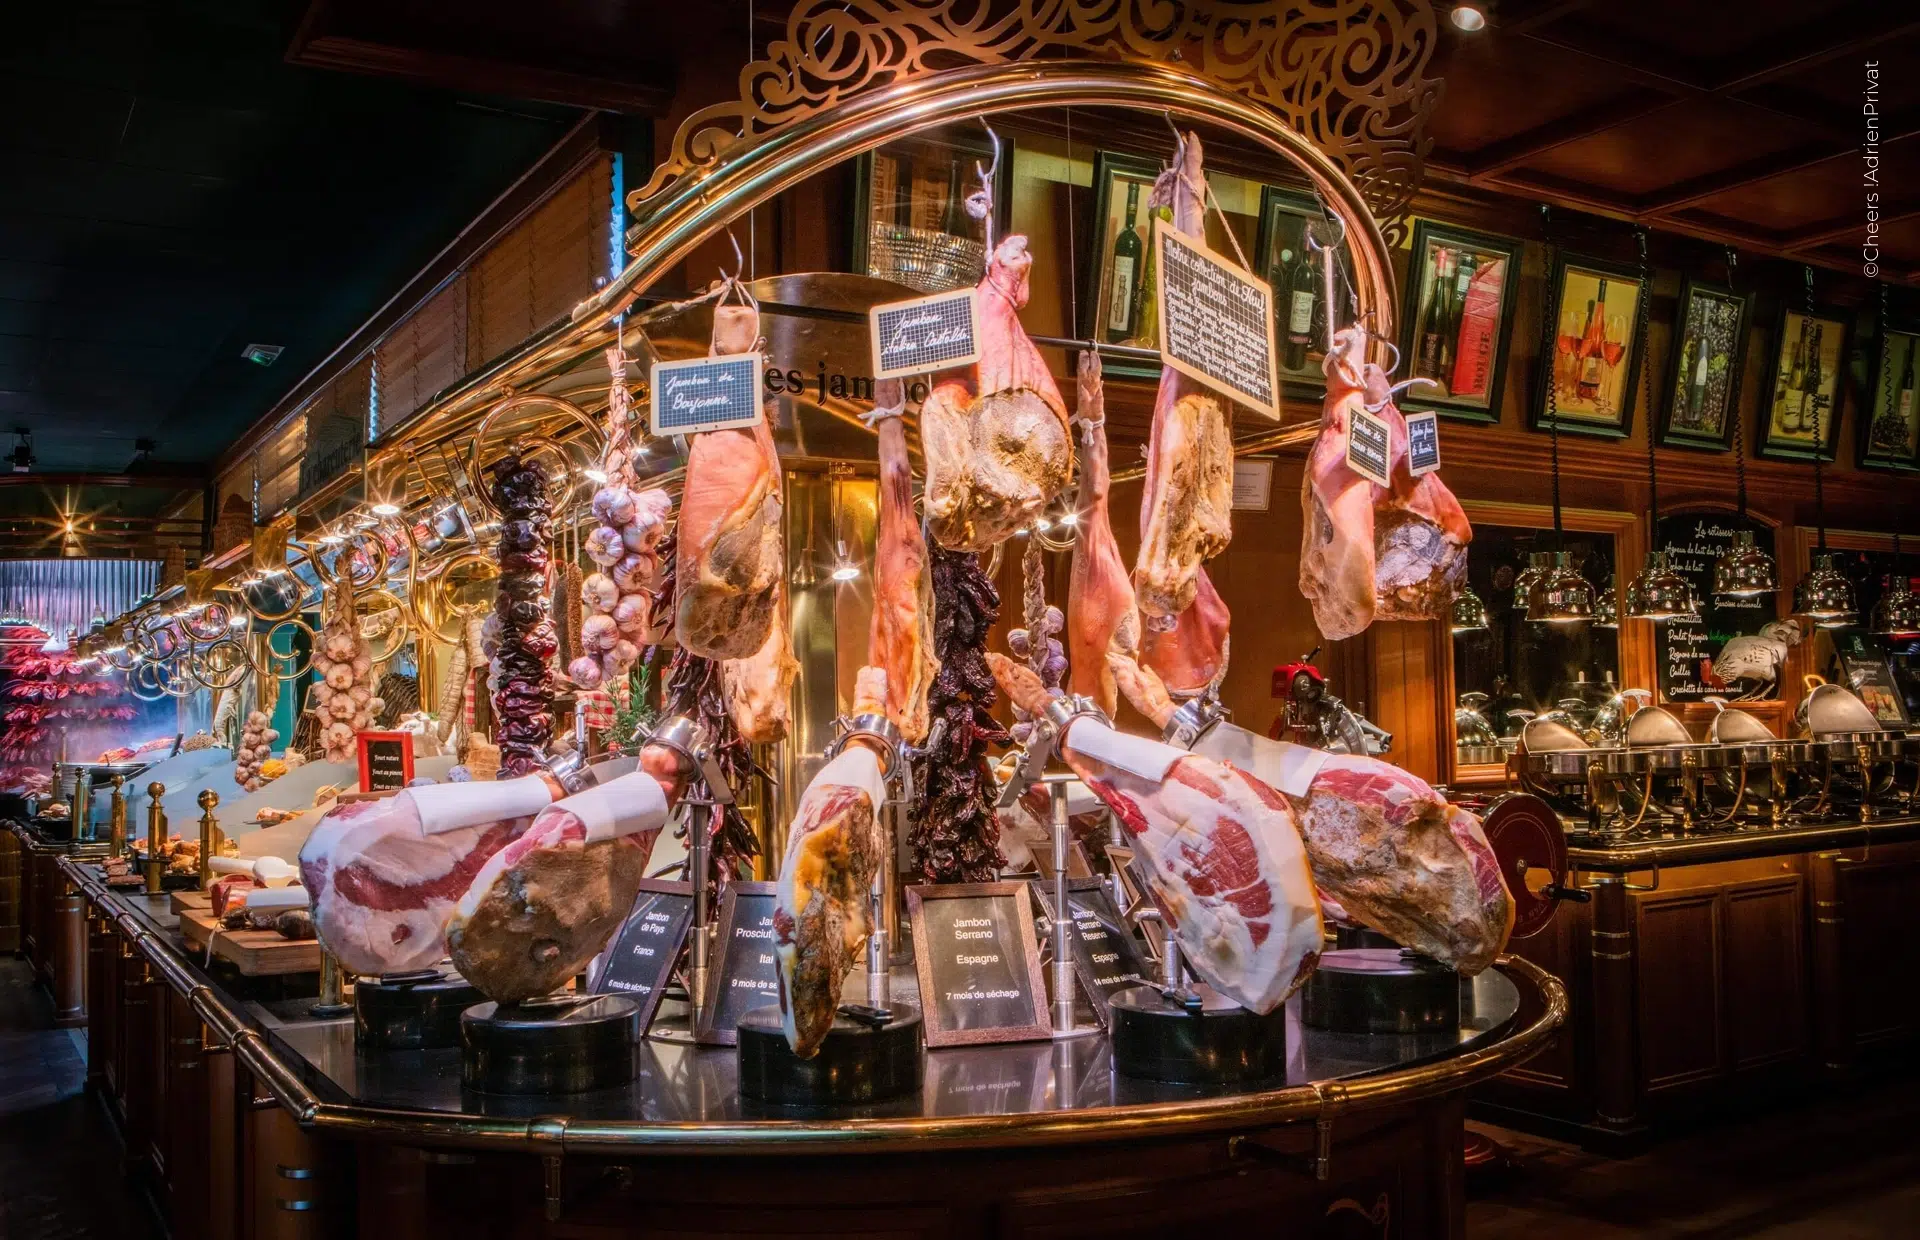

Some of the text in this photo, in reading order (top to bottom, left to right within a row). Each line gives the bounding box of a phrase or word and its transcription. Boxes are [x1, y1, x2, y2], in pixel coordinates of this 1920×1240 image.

[1190, 255, 1225, 288] collection
[1229, 280, 1240, 296] de
[1191, 273, 1227, 305] jambons
[894, 311, 943, 339] Jambon
[665, 372, 735, 396] Jambon de
[764, 360, 929, 406] es jamo
[1695, 520, 1734, 539] La rôtisseri
[1687, 542, 1694, 554] de
[1695, 543, 1707, 555] lait
[1685, 559, 1692, 571] de
[1693, 560, 1705, 571] lait
[1668, 629, 1688, 642] Poulet
[1691, 646, 1698, 658] de
[1669, 664, 1691, 678] Cailles
[645, 911, 670, 922] Jambon
[1072, 910, 1096, 920] Jambon
[953, 917, 992, 928] Jambon
[1076, 921, 1102, 930] Serrano
[641, 922, 666, 935] de Pays
[735, 928, 772, 939] Prosciut
[955, 930, 993, 940] Serrano
[1081, 931, 1108, 941] Reserva
[633, 945, 655, 956] France
[759, 953, 774, 964] Ital
[956, 955, 999, 966] Espagne
[1091, 953, 1120, 964] Espagne
[612, 981, 624, 989] mois
[624, 982, 631, 990] de
[731, 979, 738, 987] 9
[738, 979, 757, 988] mois
[757, 980, 768, 989] de
[1093, 978, 1102, 986] 14
[1101, 976, 1114, 985] mois
[1113, 975, 1121, 983] de
[946, 989, 1020, 1001] 7 mois de séchage
